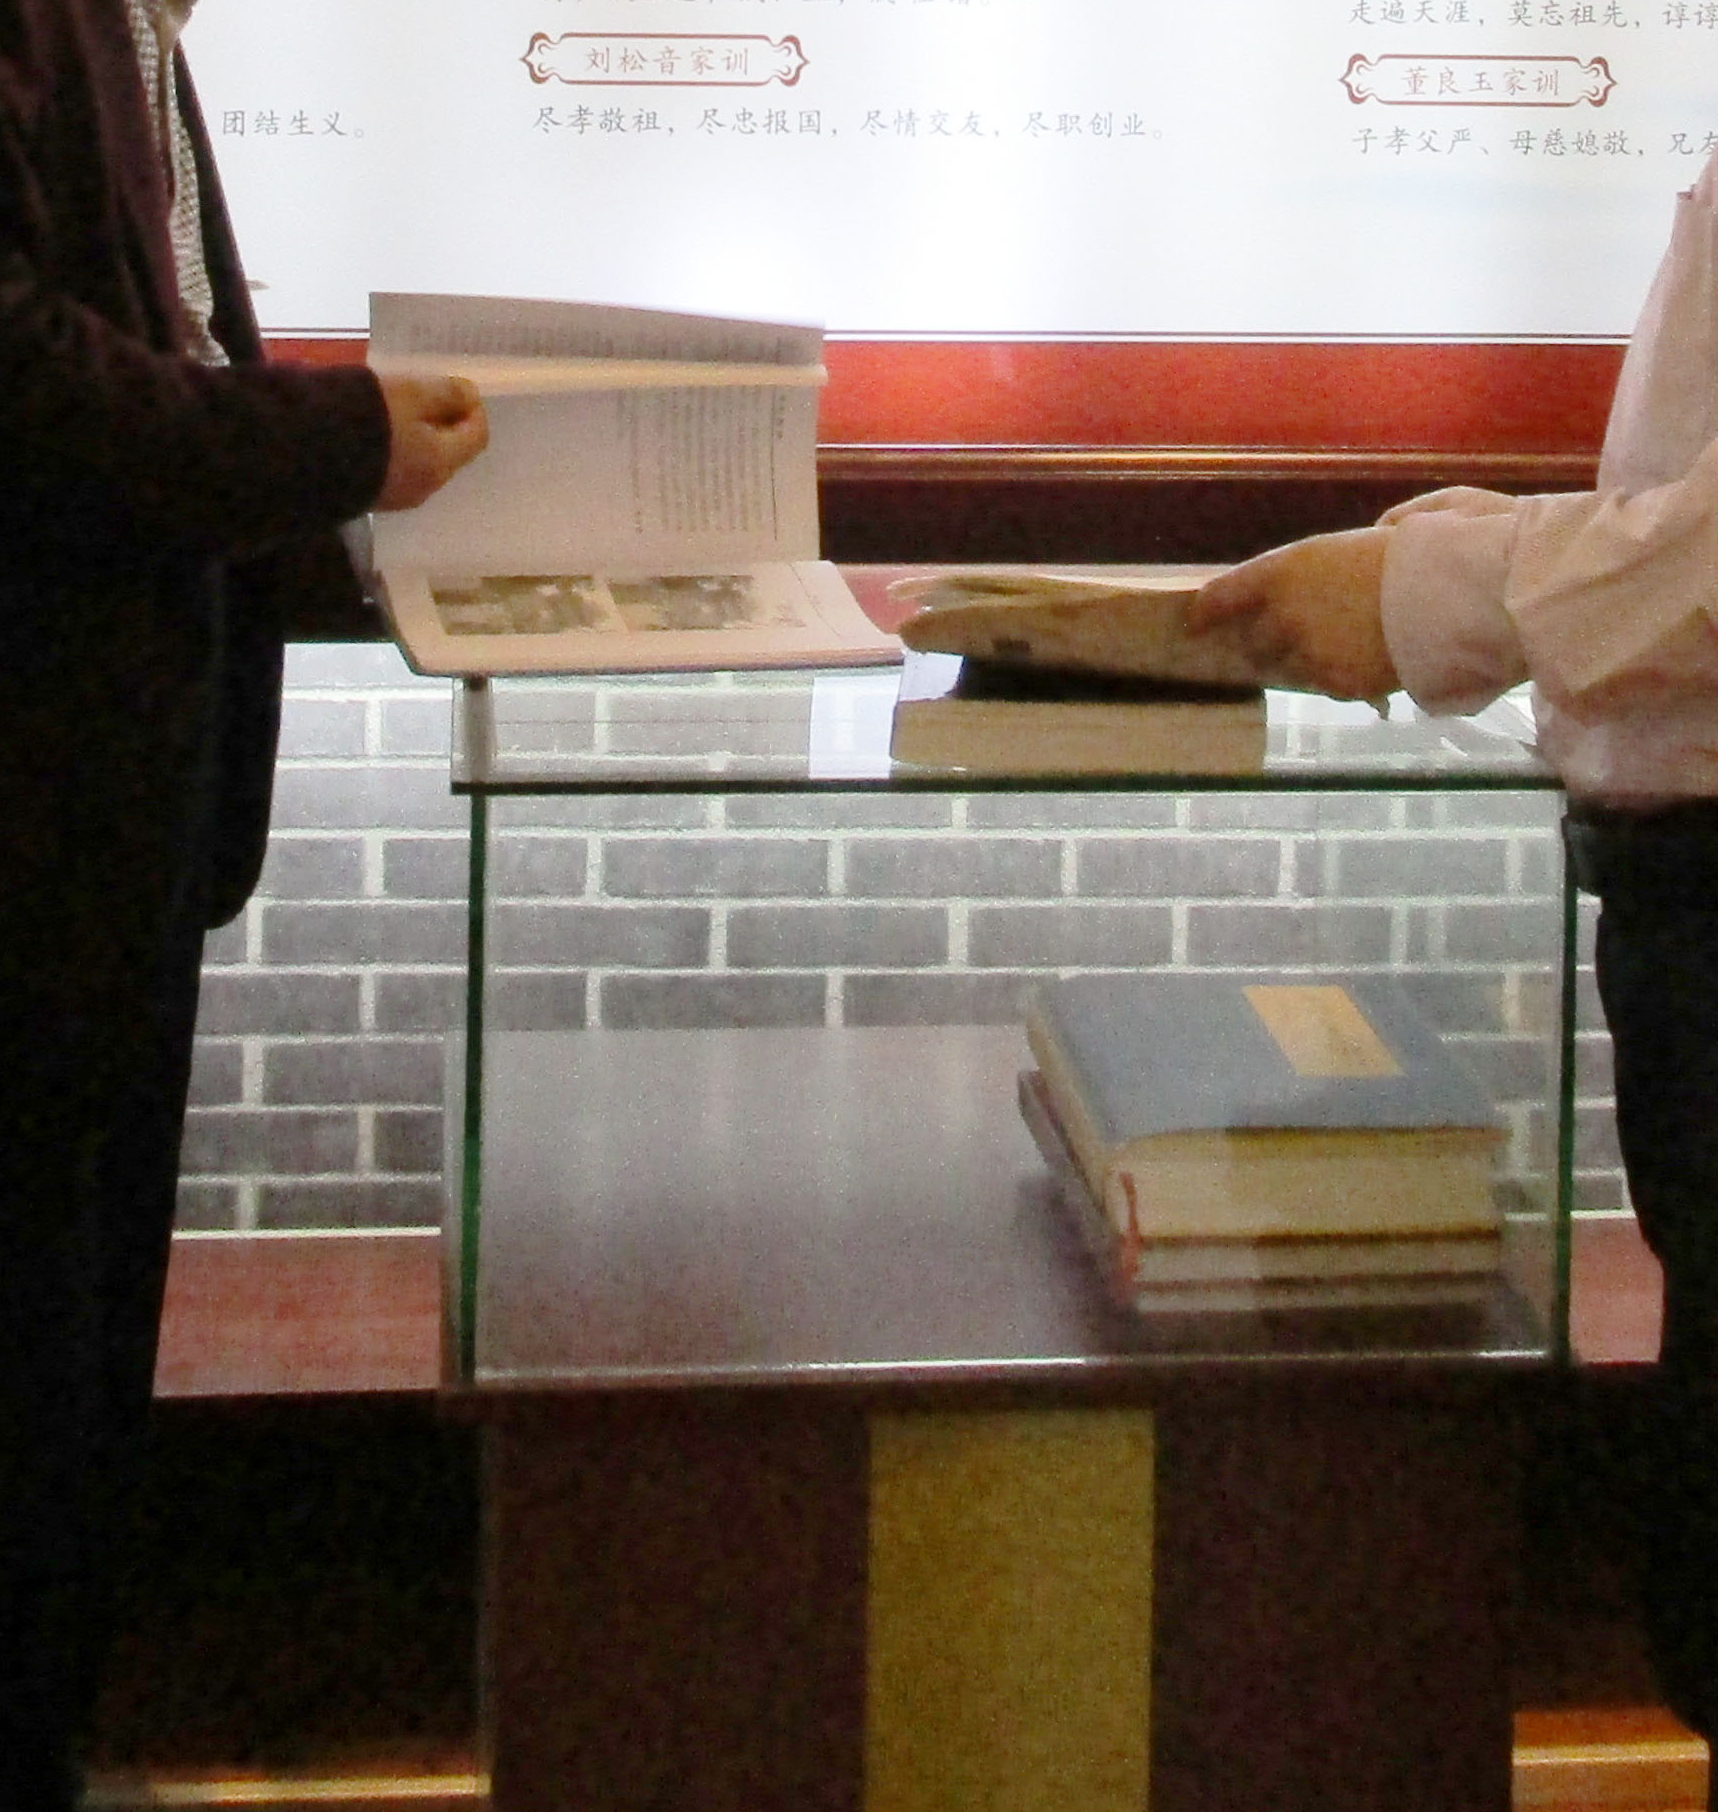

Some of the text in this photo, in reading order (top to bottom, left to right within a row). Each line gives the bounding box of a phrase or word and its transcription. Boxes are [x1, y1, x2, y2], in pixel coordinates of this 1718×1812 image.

[585, 45, 751, 76] 刘松音家训
[1401, 66, 1562, 99] 董良玉家训
[220, 109, 365, 139] 团结生义。
[532, 105, 1165, 142] 尽孝敬祖，尽忠报国，尽情交友，尽职创业。
